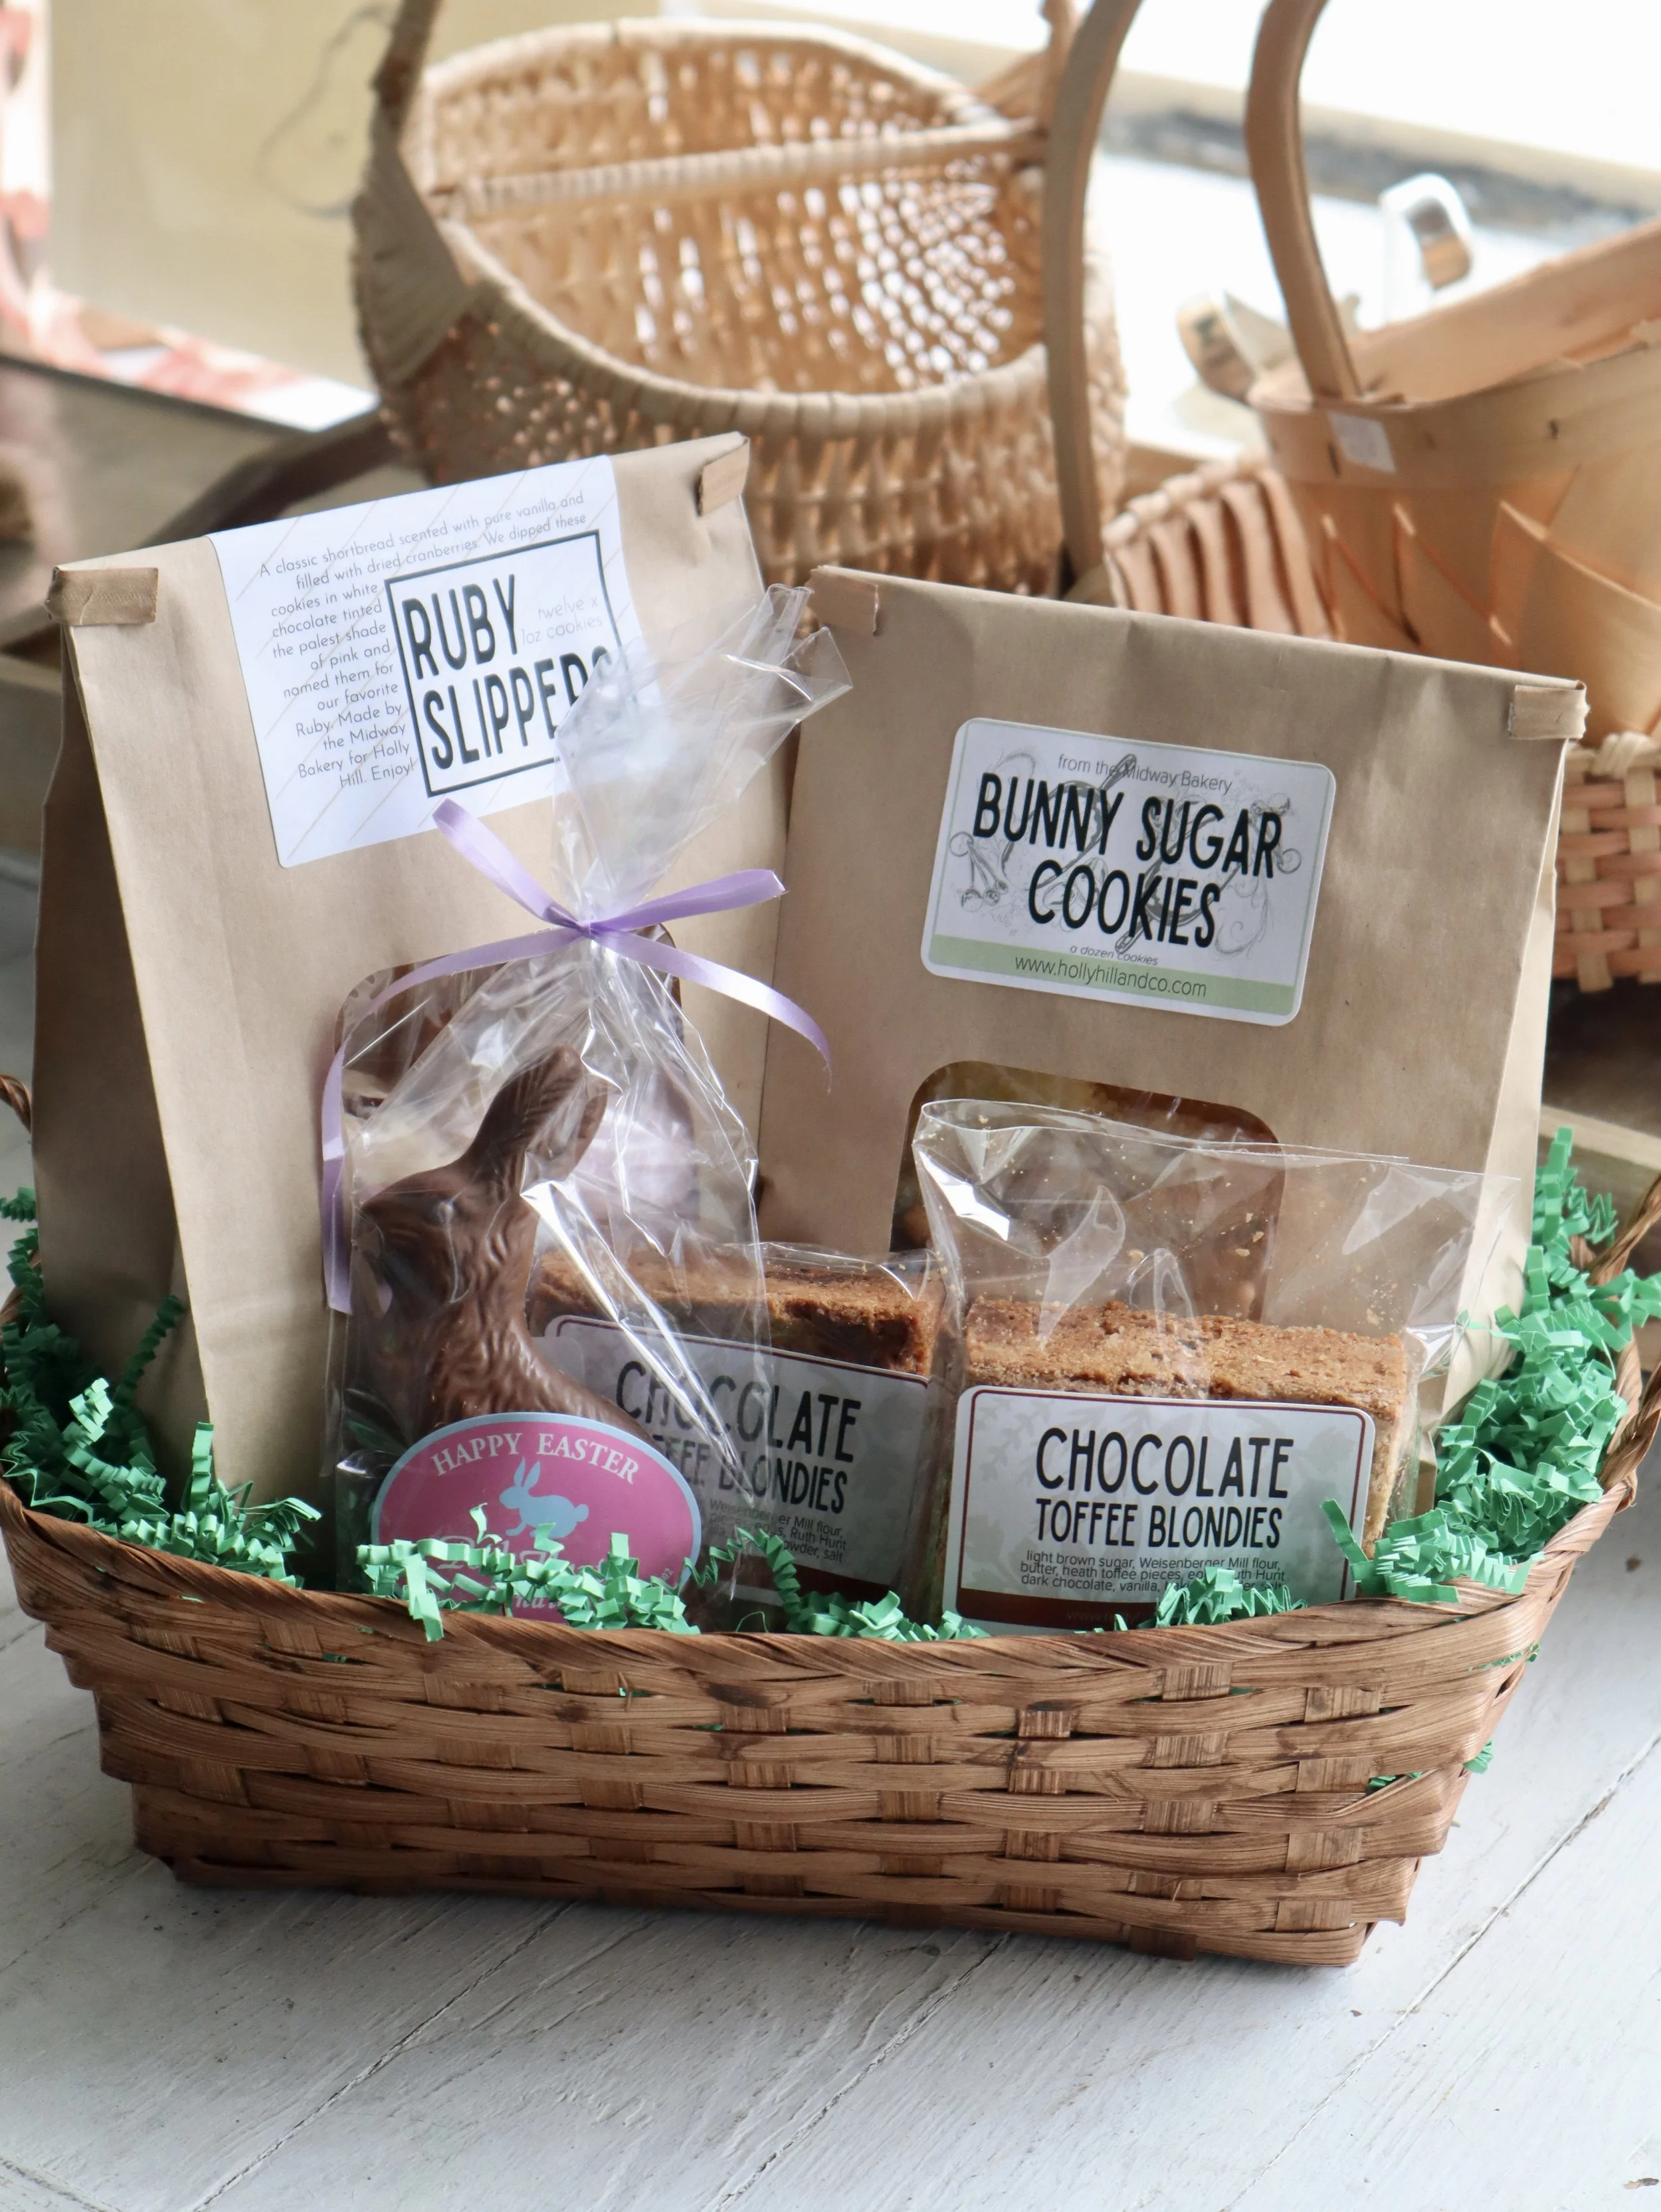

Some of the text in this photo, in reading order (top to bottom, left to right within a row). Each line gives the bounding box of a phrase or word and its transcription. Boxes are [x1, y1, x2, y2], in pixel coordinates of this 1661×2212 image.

[260, 490, 584, 577] A classic shortbread scented with pure vanilla and
[296, 514, 586, 590] filled with dried cranberries. We dipped these
[271, 584, 378, 617] cookies in white
[538, 595, 599, 619] twelve x
[272, 599, 383, 638] chocolate tinted
[401, 573, 518, 680] RUBY
[547, 614, 603, 639] cookies
[273, 620, 386, 659] the palest shade
[310, 638, 391, 670] of pink and
[284, 661, 394, 698] named them for
[317, 683, 398, 711] our favorite
[338, 705, 380, 727] Made
[385, 701, 401, 716] by
[323, 723, 405, 751] the Midway
[298, 739, 409, 779] Bakery for Holly
[340, 757, 415, 788] Hill. Enjoy!
[1058, 753, 1232, 796] from the Midway Bakery
[973, 772, 1282, 878] BUNNY SUGAR
[1028, 860, 1222, 948] COOKIES
[1080, 944, 1114, 959] dozen
[1116, 951, 1159, 966] cookies
[1015, 956, 1207, 998] www.hollyhillandco.com
[431, 1433, 640, 1485] HAPPY EASTER
[1035, 1427, 1295, 1499] CHOCOLATE
[790, 1527, 816, 1543] Ruth
[819, 1535, 847, 1551] Hunt
[794, 1515, 814, 1531] Mill
[817, 1519, 843, 1539] flour,
[1035, 1498, 1283, 1549] TOFFEE BLONDIES
[784, 1539, 844, 1563] owder, salt
[1026, 1550, 1054, 1566] light
[1056, 1552, 1096, 1566] brown
[1099, 1557, 1135, 1571] sugar,
[1229, 1558, 1251, 1569] Mill
[1252, 1558, 1281, 1571] flour,
[1021, 1561, 1058, 1577] butter,
[1062, 1565, 1098, 1579] heath
[1102, 1568, 1137, 1580] toffee
[1140, 1568, 1184, 1584] pieces,
[1256, 1570, 1286, 1582] Hunt
[1021, 1573, 1049, 1586] dark
[1052, 1576, 1116, 1592] chocolate,
[1120, 1580, 1161, 1593] vanilla,
